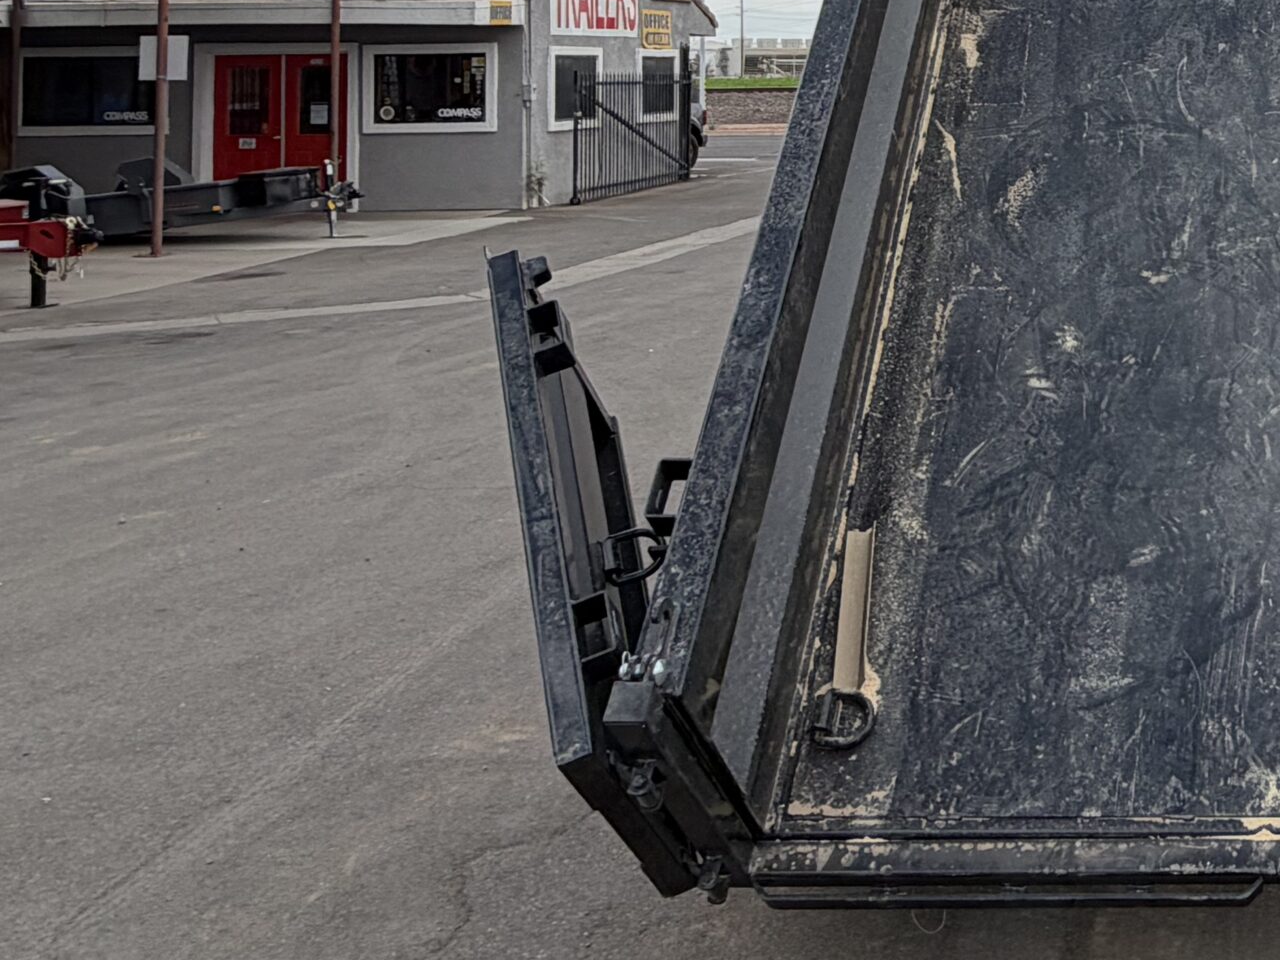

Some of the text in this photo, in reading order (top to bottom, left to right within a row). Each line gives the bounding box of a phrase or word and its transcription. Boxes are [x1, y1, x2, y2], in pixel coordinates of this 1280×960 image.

[643, 13, 670, 30] OFFICE
[103, 111, 149, 121] COMPASS
[437, 107, 482, 119] COMPASS
